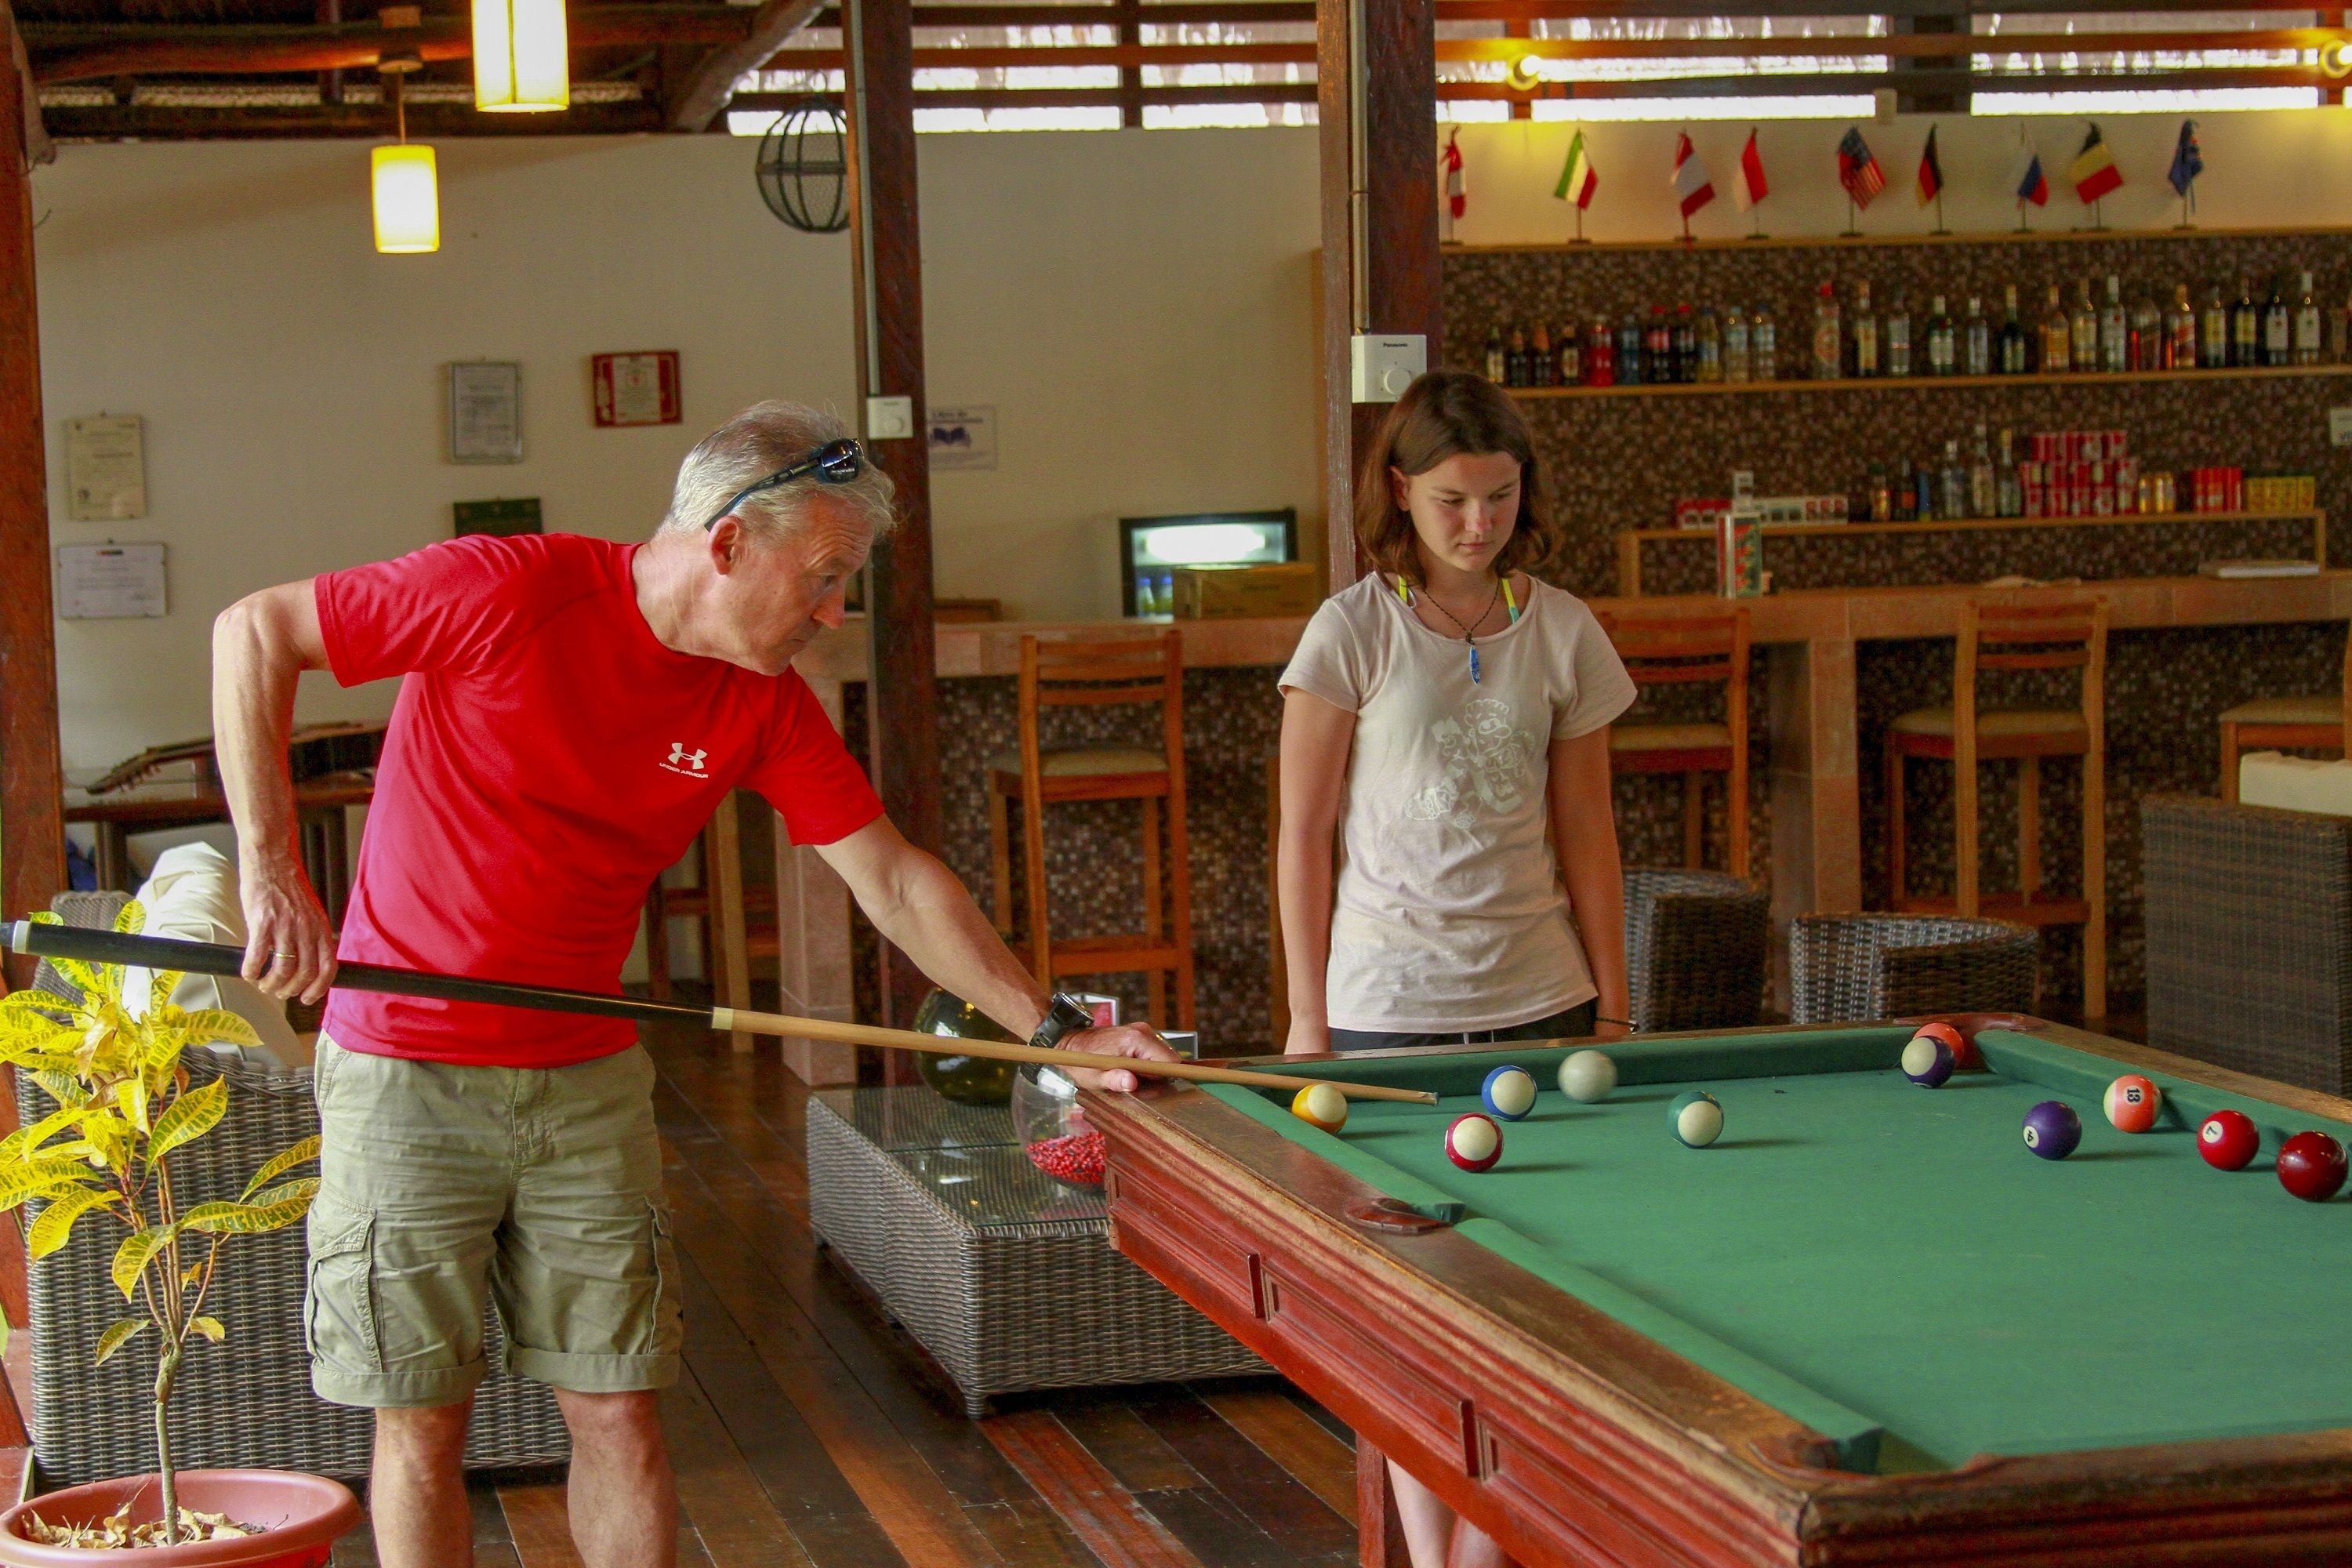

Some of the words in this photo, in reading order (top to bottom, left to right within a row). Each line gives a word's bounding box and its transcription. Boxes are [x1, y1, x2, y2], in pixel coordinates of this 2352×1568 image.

[659, 762, 681, 773] UNDER
[681, 770, 709, 779] ARMOUR
[2127, 1087, 2140, 1103] 13
[2027, 1130, 2034, 1142] 4
